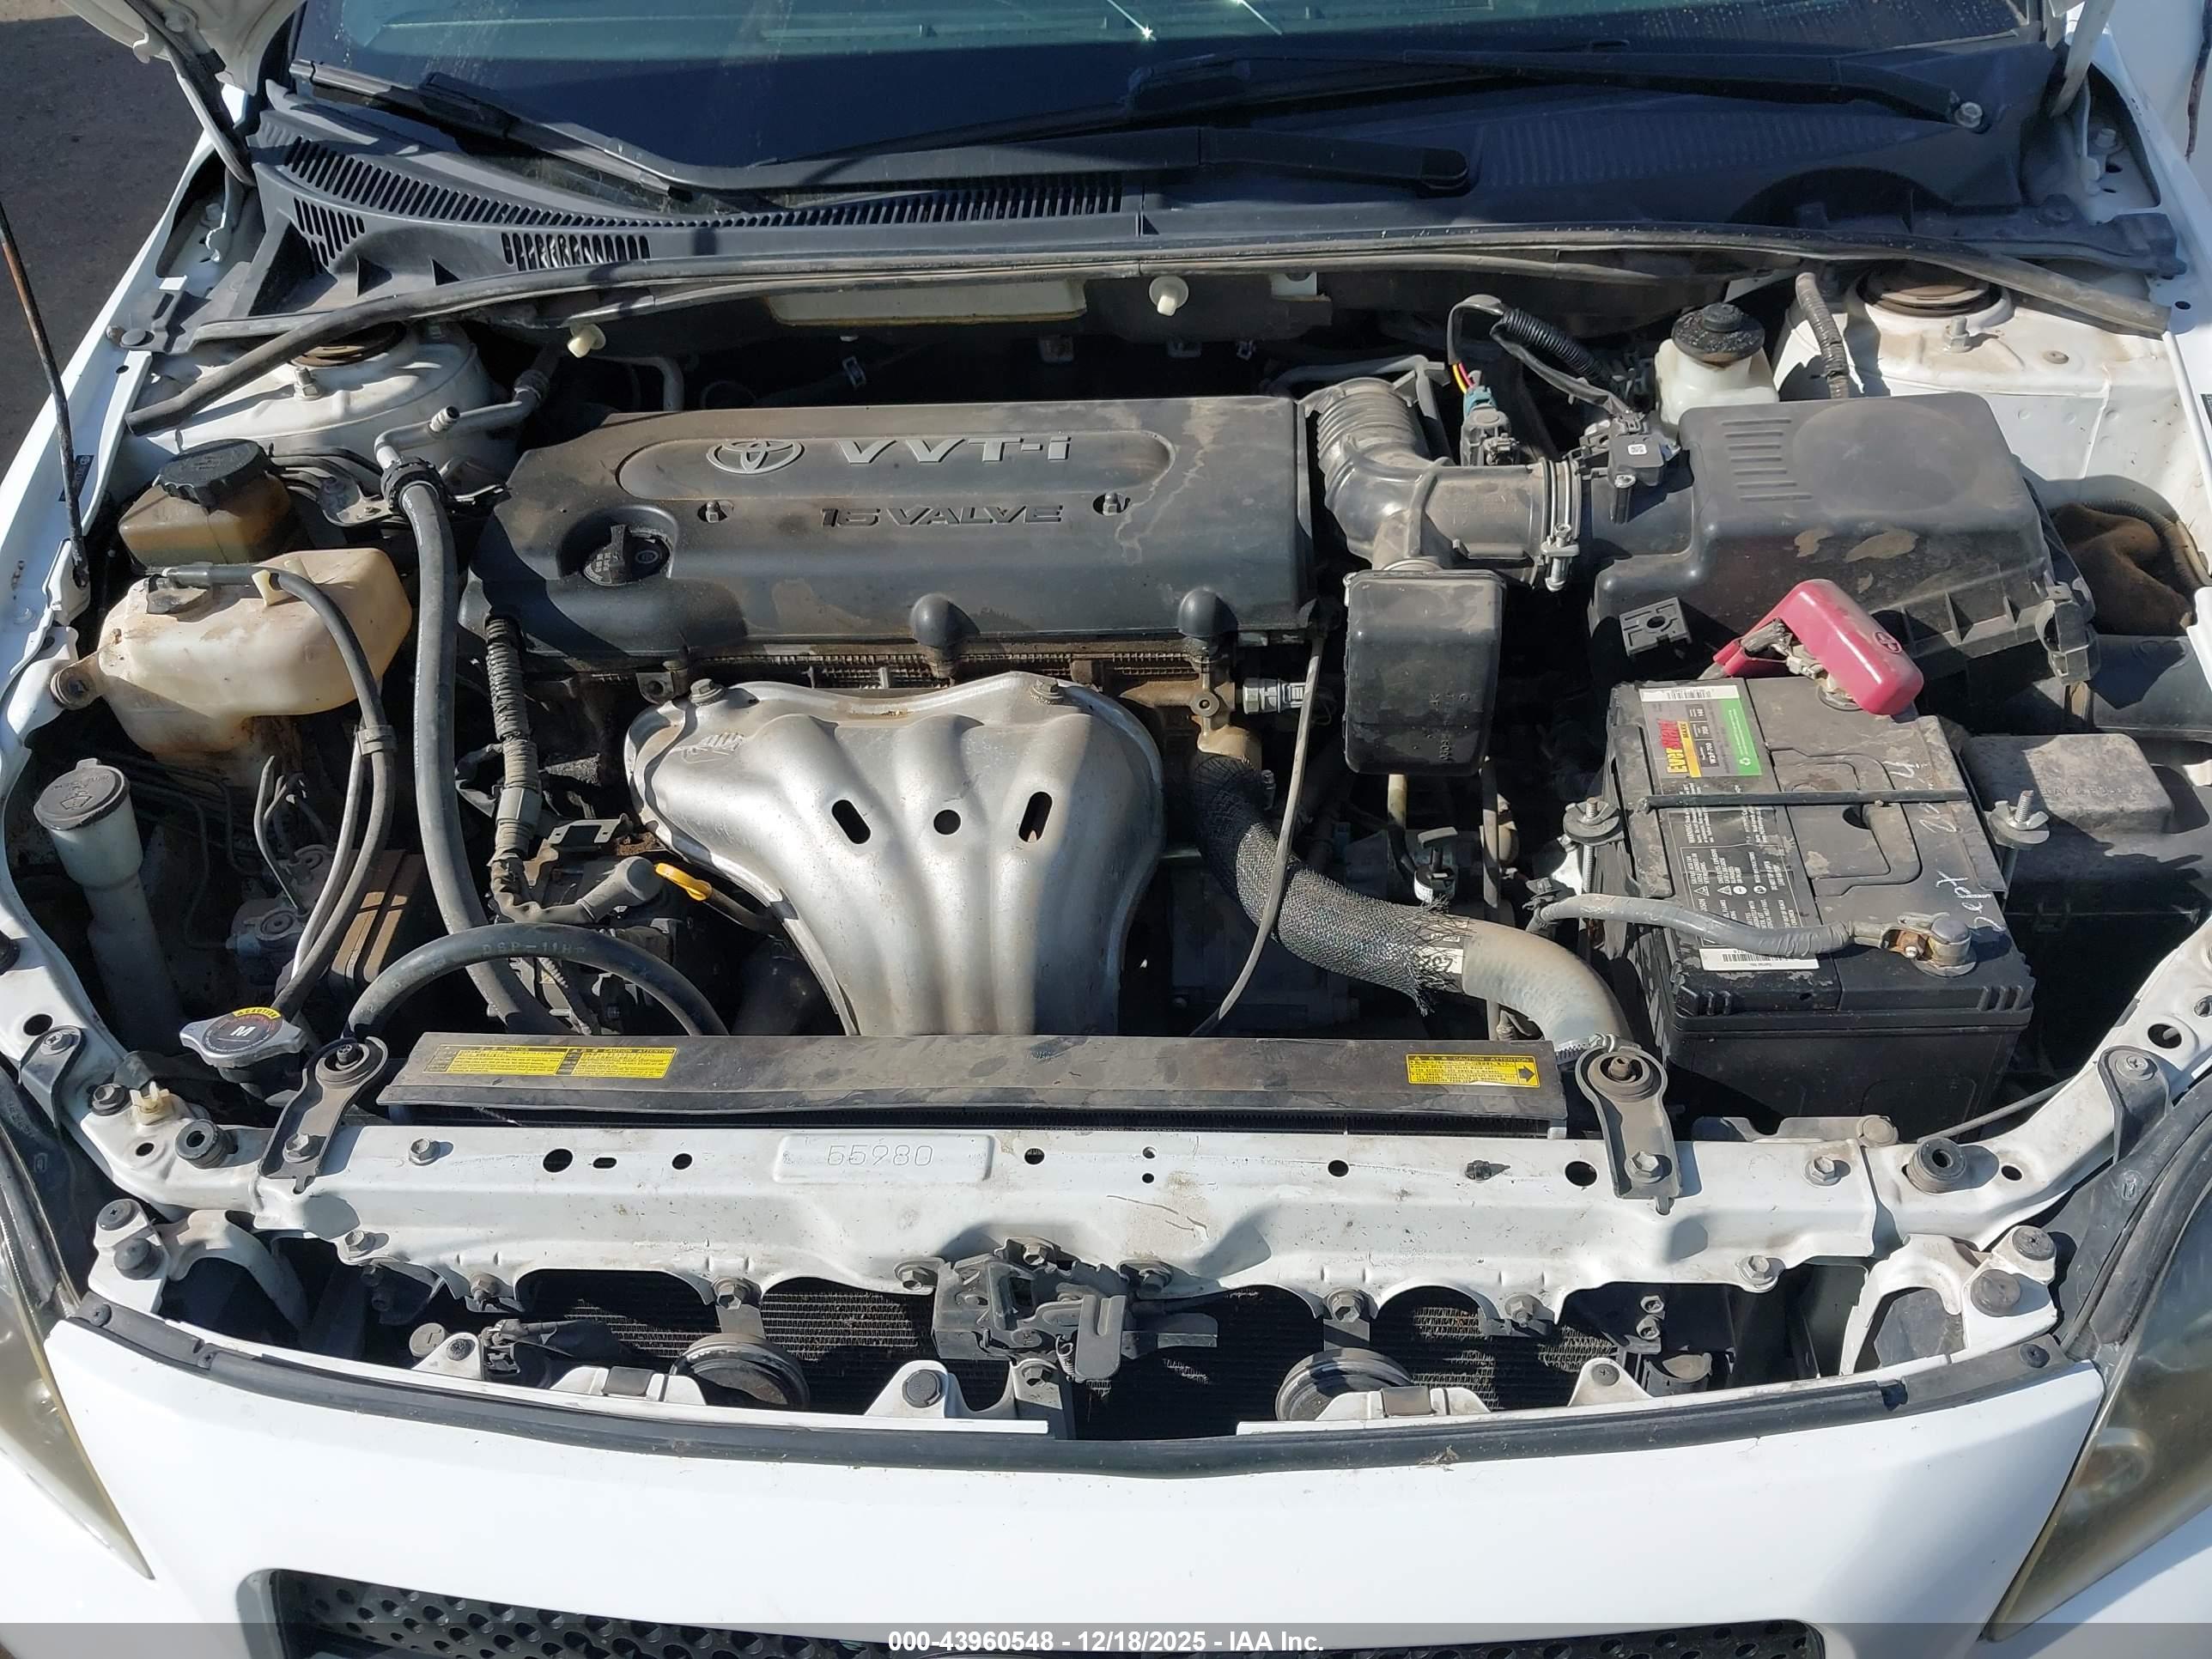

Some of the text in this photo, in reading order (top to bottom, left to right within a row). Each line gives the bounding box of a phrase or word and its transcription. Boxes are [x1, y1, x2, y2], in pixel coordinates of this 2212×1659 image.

[836, 436, 1071, 464] VVT-i
[1657, 719, 1688, 773] EverStart
[826, 1145, 934, 1166] 55980
